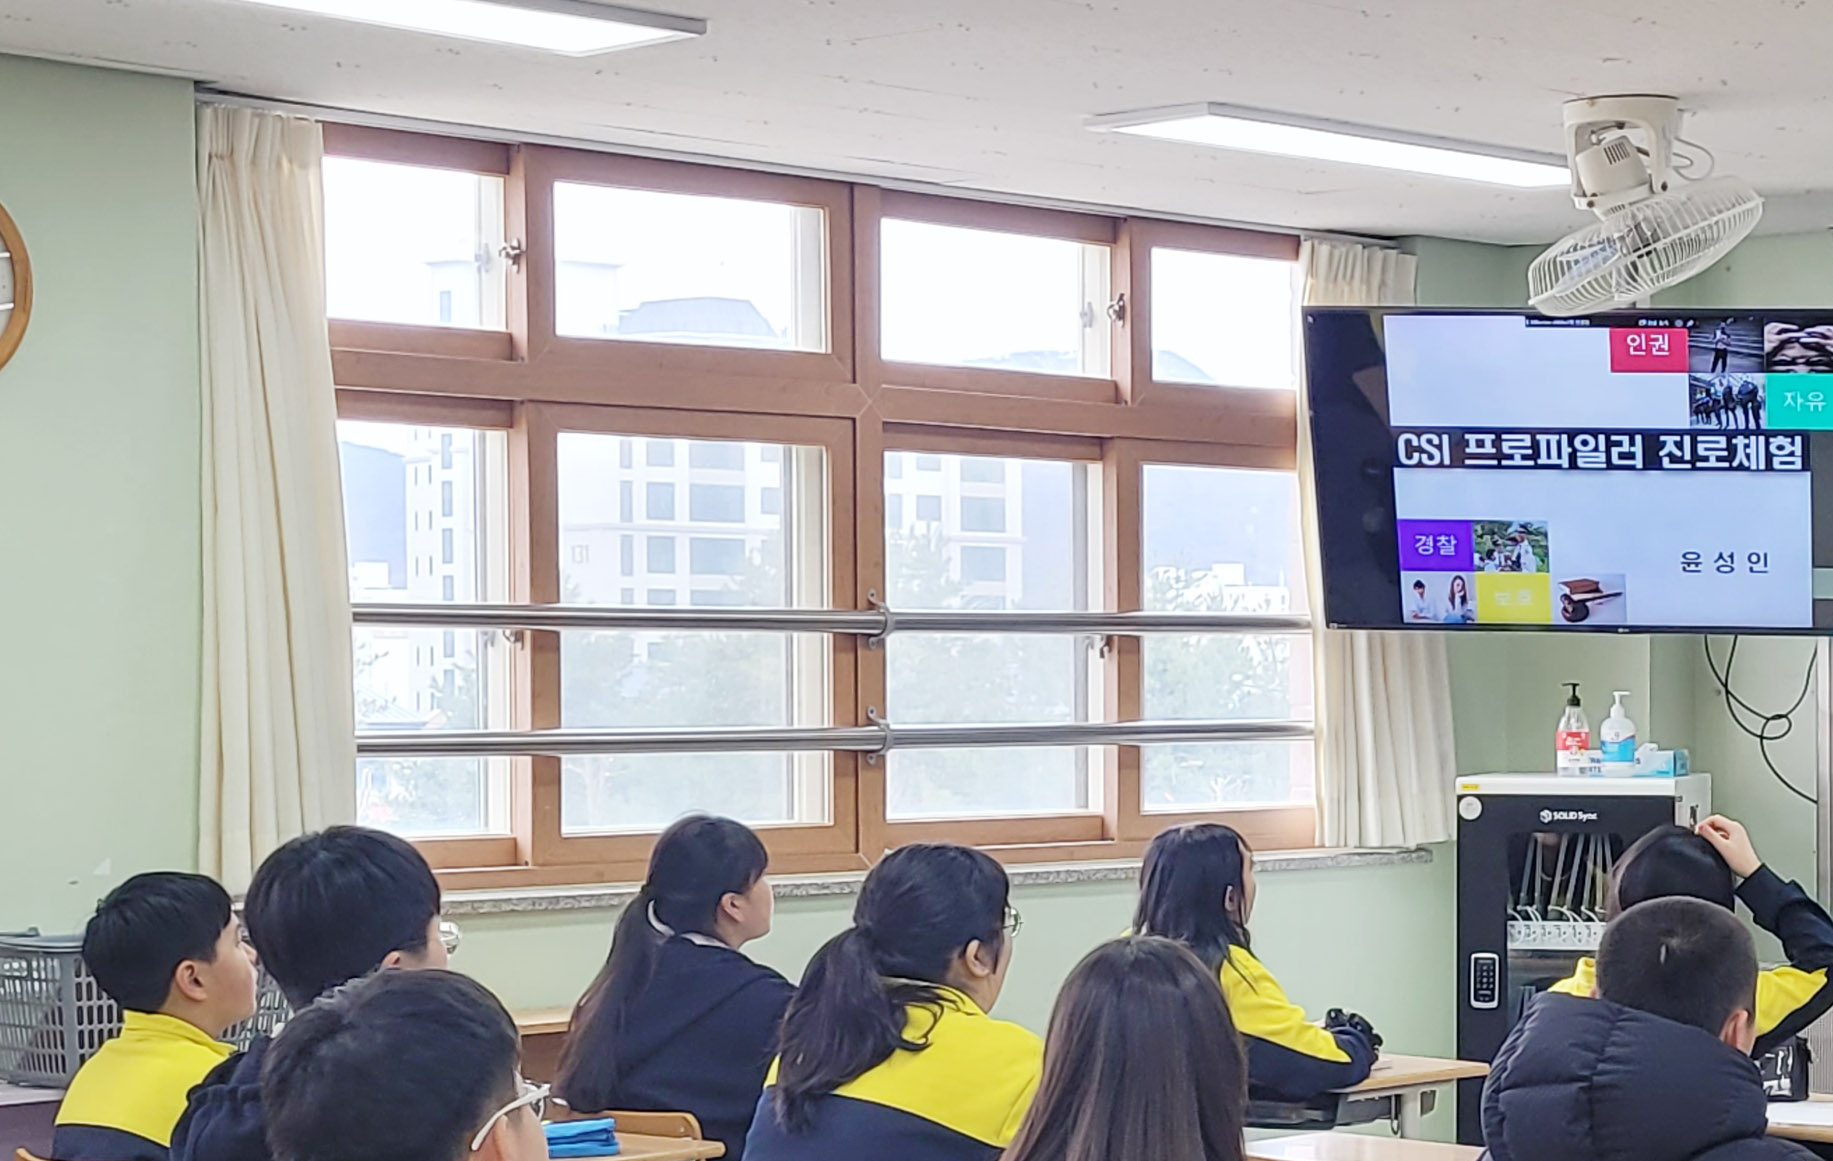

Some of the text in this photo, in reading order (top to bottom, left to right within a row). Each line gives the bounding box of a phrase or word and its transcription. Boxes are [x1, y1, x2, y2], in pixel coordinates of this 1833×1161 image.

[1626, 333, 1671, 357] 인권
[1782, 390, 1827, 413] 자유
[1397, 433, 1804, 471] CSI 프로파일러 진로체험
[1414, 533, 1457, 556] 경찰
[1553, 811, 1578, 820] SOLID
